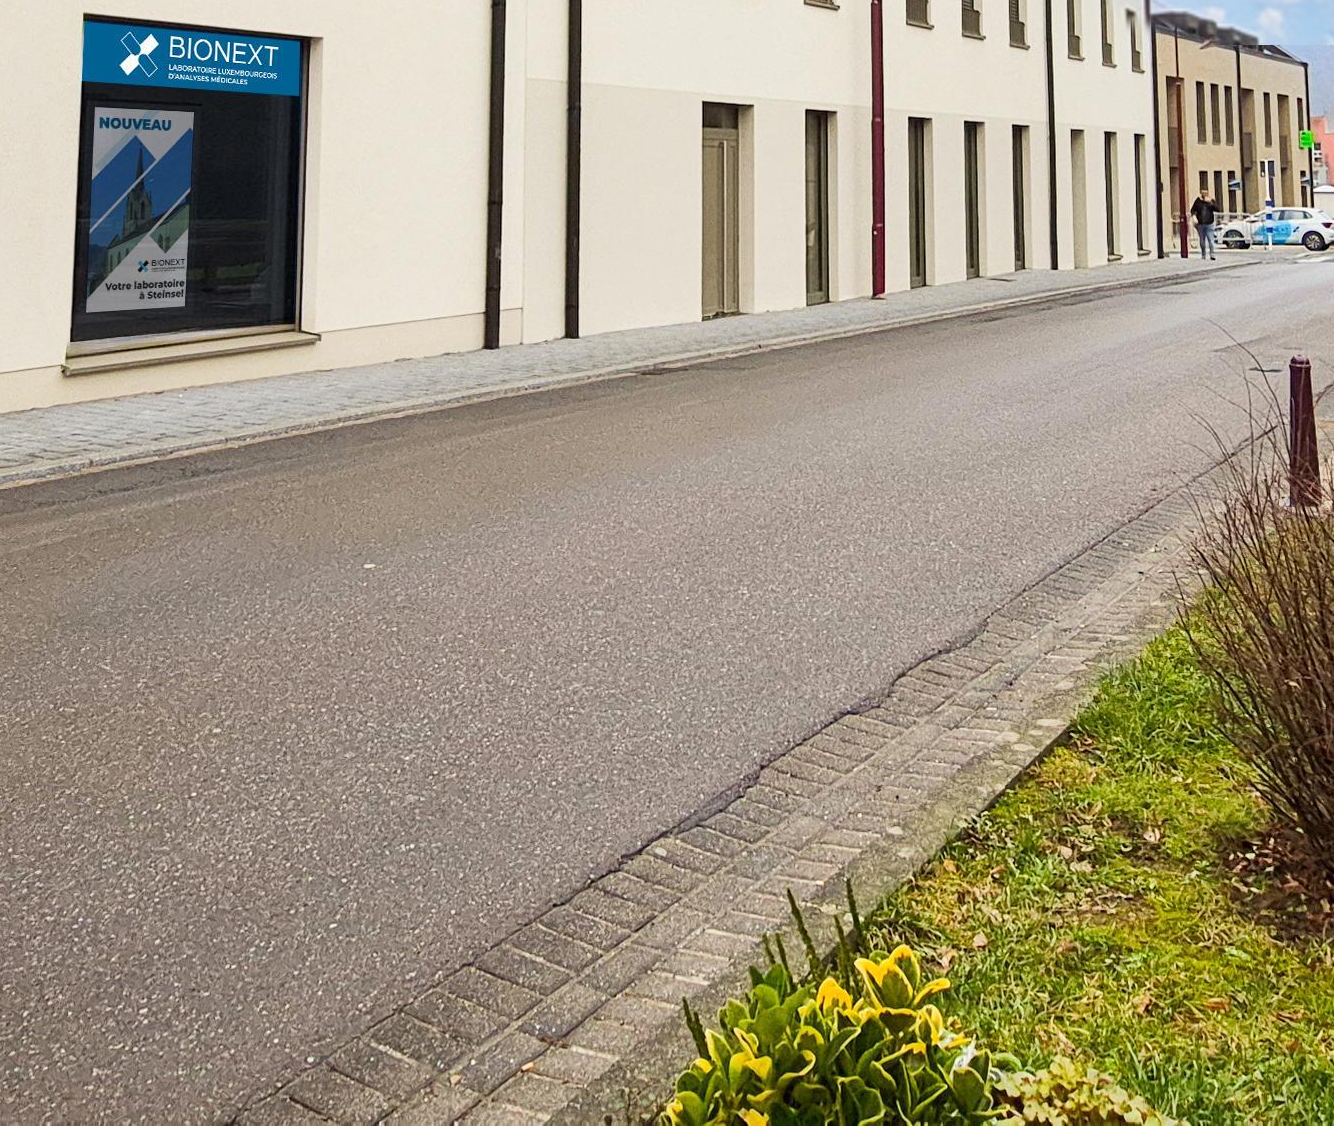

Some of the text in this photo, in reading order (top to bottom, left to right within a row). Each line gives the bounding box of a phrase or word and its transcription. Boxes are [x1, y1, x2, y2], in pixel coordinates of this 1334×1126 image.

[169, 35, 279, 67] BIONEXT
[168, 63, 278, 80] LABORATOIRE LUXEMBOURGEOIS
[168, 73, 248, 85] D'ANALYSES MÉDICALES
[99, 116, 172, 131] NOUVEAU
[151, 258, 185, 267] BIONEXT
[105, 278, 185, 291] Votre laboratoire
[139, 289, 184, 300] à Steinsel
